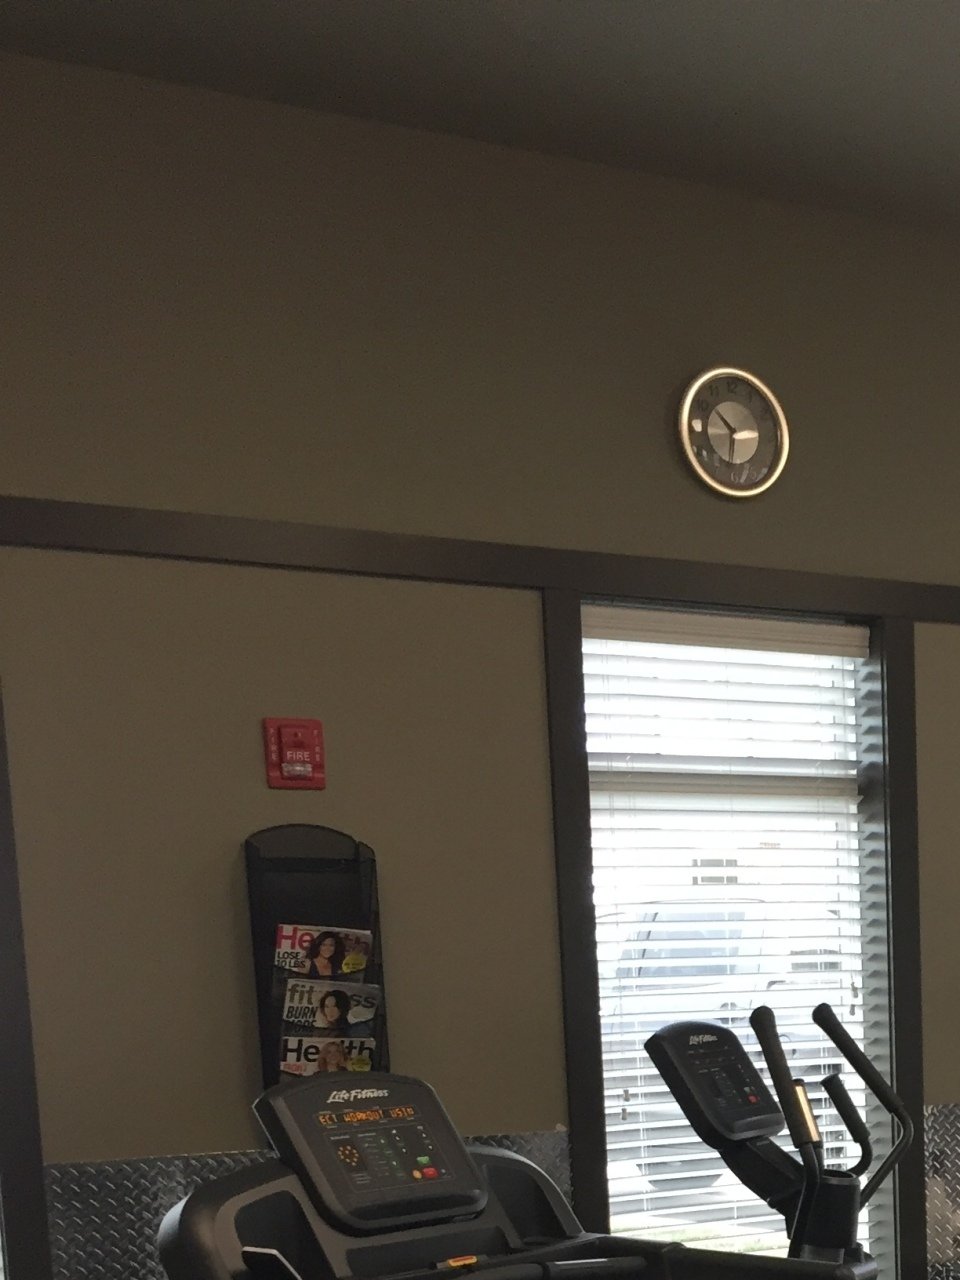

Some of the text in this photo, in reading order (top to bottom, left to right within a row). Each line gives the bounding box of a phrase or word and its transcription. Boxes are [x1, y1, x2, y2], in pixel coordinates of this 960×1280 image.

[286, 750, 311, 762] FIRE
[277, 951, 302, 960] LOSE
[276, 959, 306, 969] 10 LBS
[286, 1005, 319, 1020] BURN
[281, 1038, 374, 1063] Heth
[342, 1109, 385, 1122] WORKOUT
